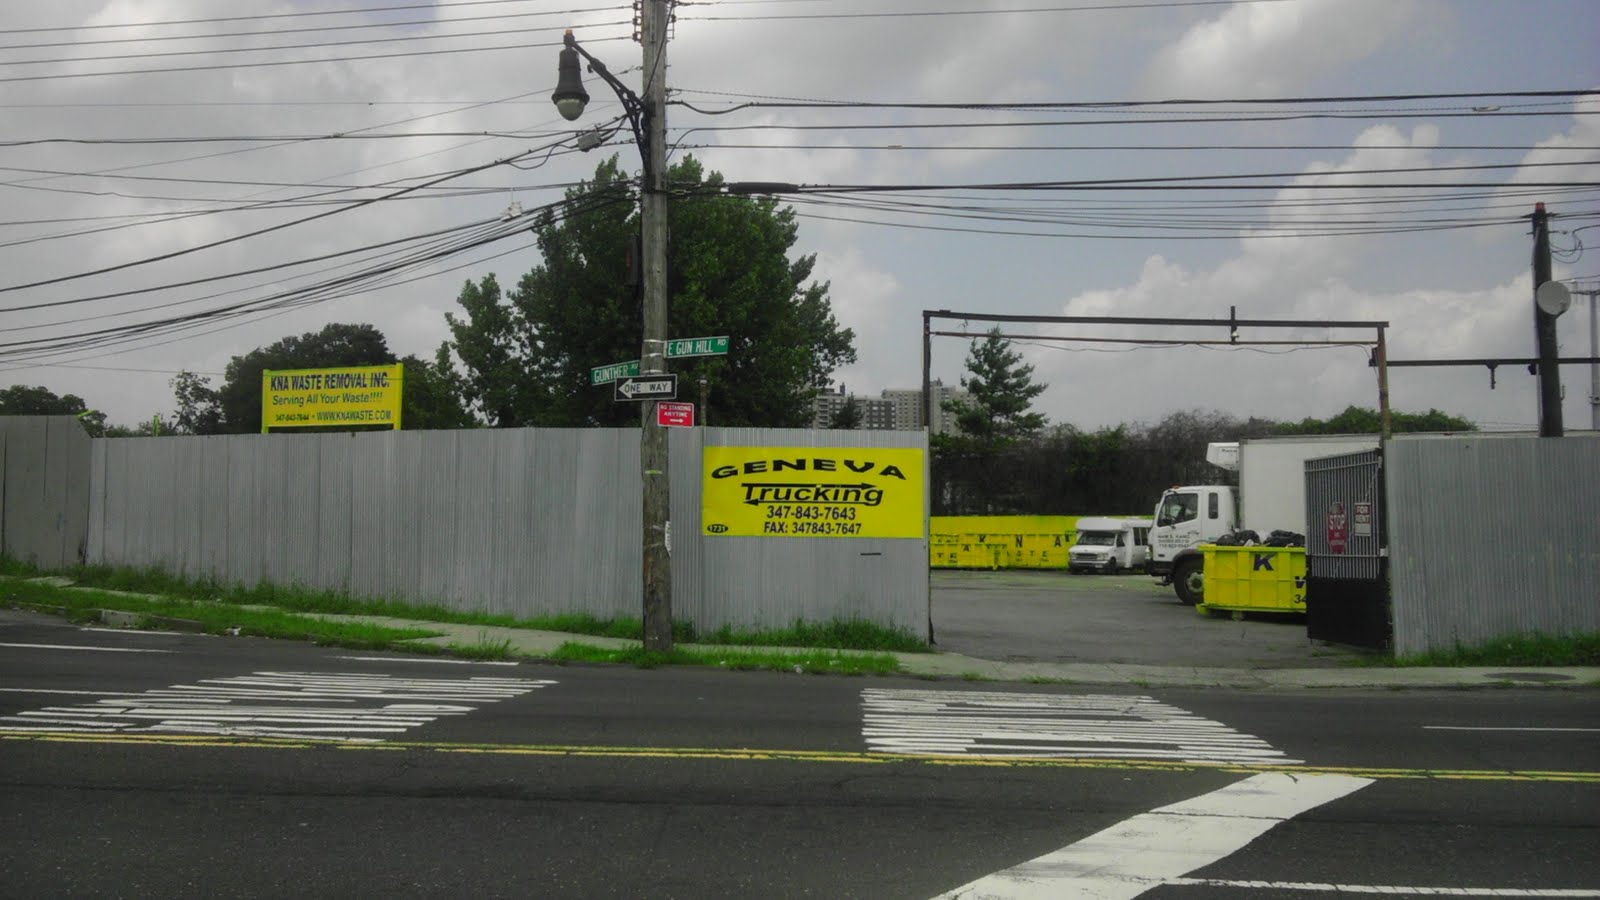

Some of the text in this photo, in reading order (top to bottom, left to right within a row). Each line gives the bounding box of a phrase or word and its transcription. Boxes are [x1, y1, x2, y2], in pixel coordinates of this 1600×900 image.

[667, 338, 727, 355] E GUN HILL RD
[270, 371, 390, 391] KNA WASTE REMOVAL INC.
[594, 365, 629, 383] GUNTHER
[624, 383, 668, 393] ONE WAY
[272, 395, 305, 407] Serving
[307, 394, 318, 403] All
[320, 393, 340, 403] Your
[317, 410, 392, 421] WWW.KNAWASTE.COM
[712, 459, 907, 480] GENEVA
[742, 483, 884, 506] Trucking
[767, 505, 857, 520] 347-843-7643
[764, 522, 862, 534] FAX: 347843-7647
[1329, 514, 1345, 530] STOP
[1253, 552, 1276, 571] K
